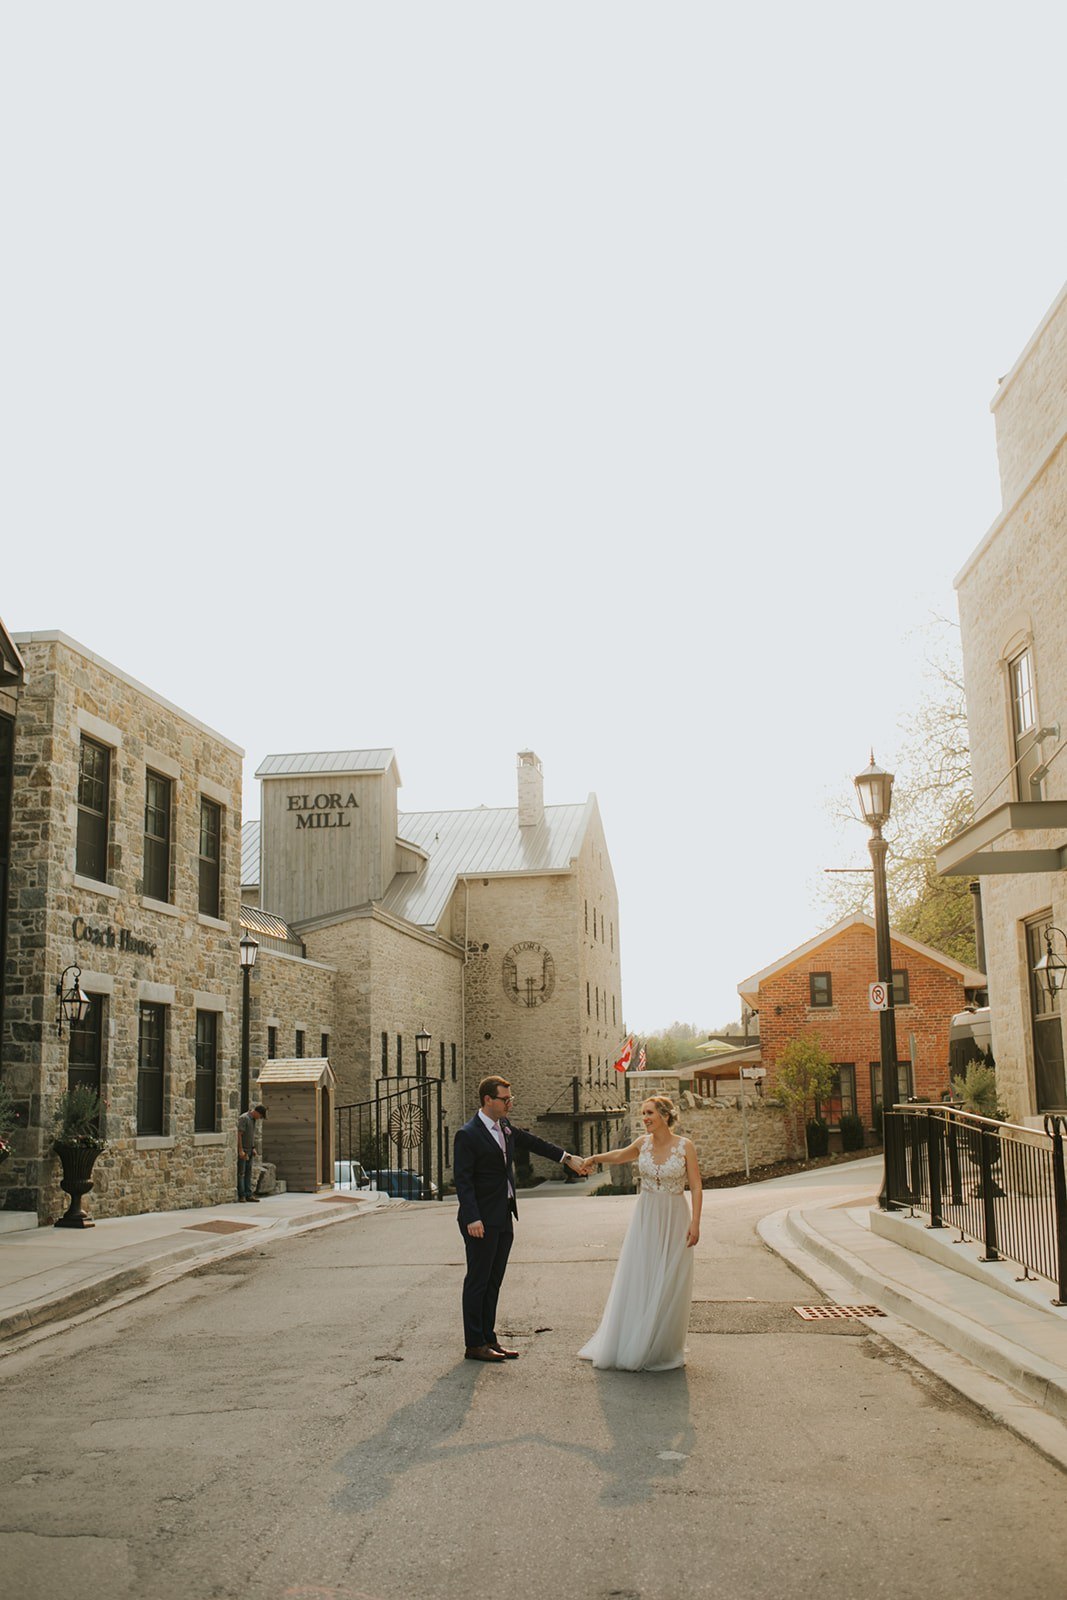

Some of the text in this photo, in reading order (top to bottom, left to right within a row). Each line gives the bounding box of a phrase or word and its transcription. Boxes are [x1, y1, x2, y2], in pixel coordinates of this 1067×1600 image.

[287, 793, 360, 811] ELORA
[296, 812, 351, 829] MILL
[72, 917, 157, 958] Coach House
